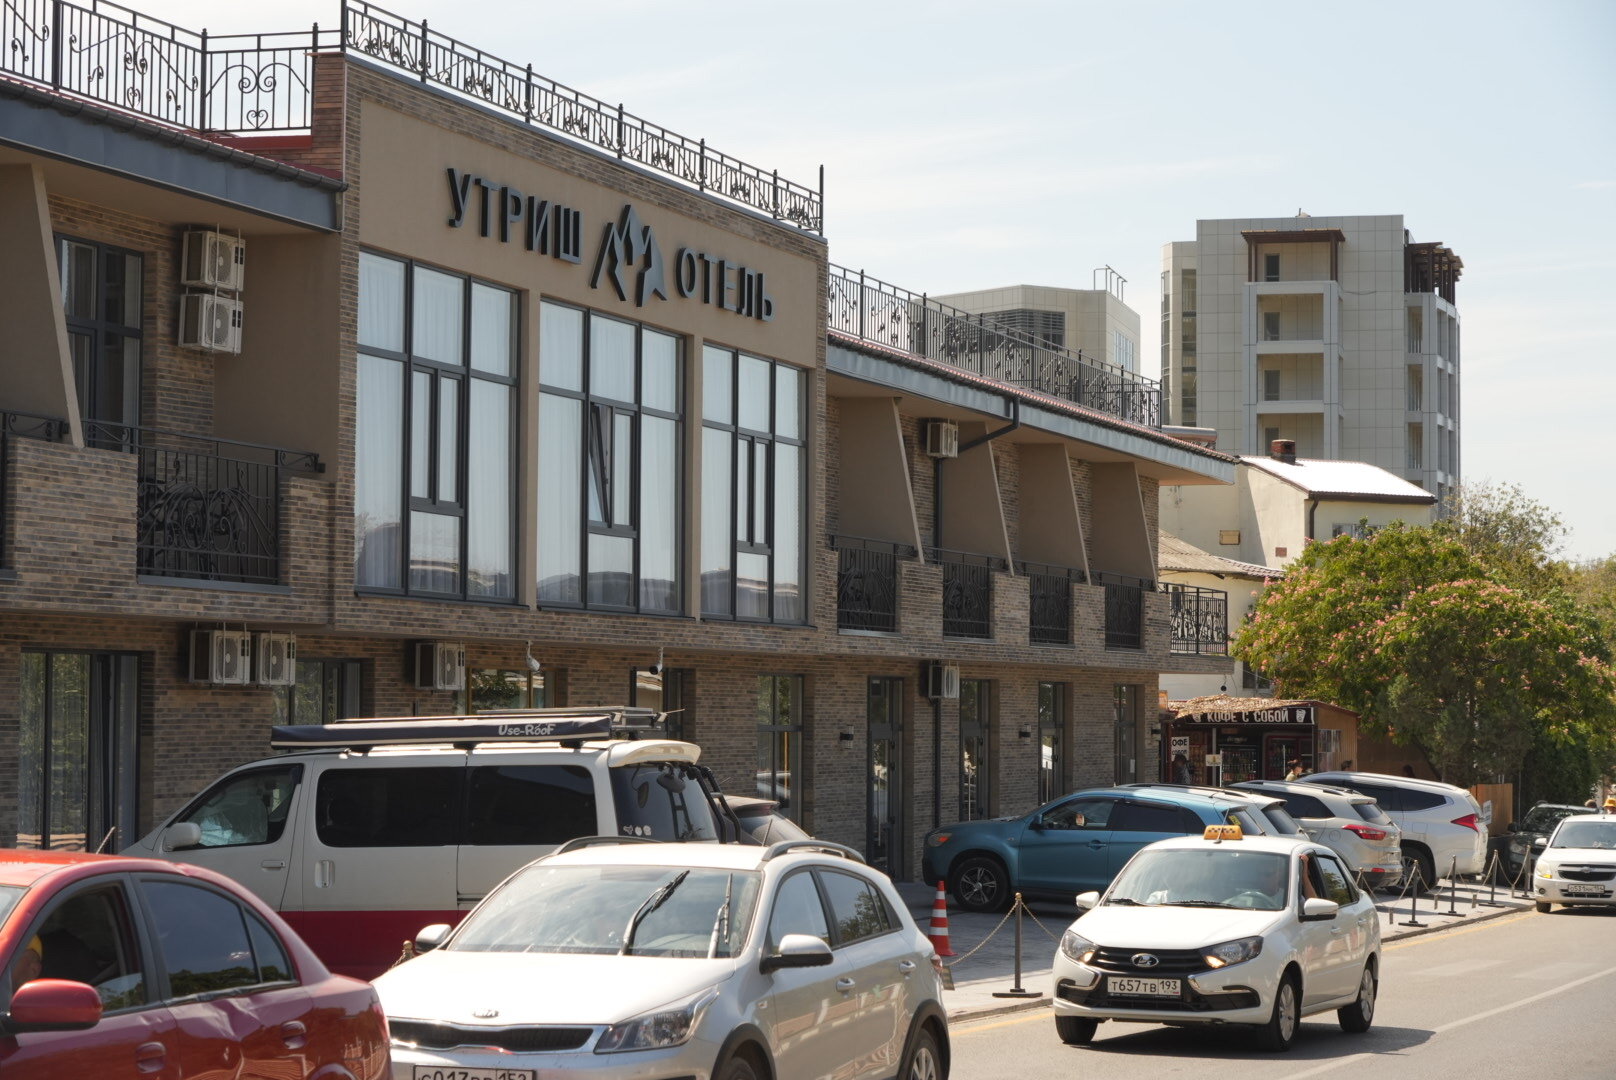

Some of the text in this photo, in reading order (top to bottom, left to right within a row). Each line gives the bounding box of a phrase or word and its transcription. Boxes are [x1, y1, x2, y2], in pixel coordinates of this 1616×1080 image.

[447, 167, 584, 265] УТРИШ
[676, 247, 775, 323] ОТЕЛЬ
[1207, 708, 1289, 723] КОФЕ С СОБОЙ
[1112, 979, 1177, 993] Т657ТВ 193
